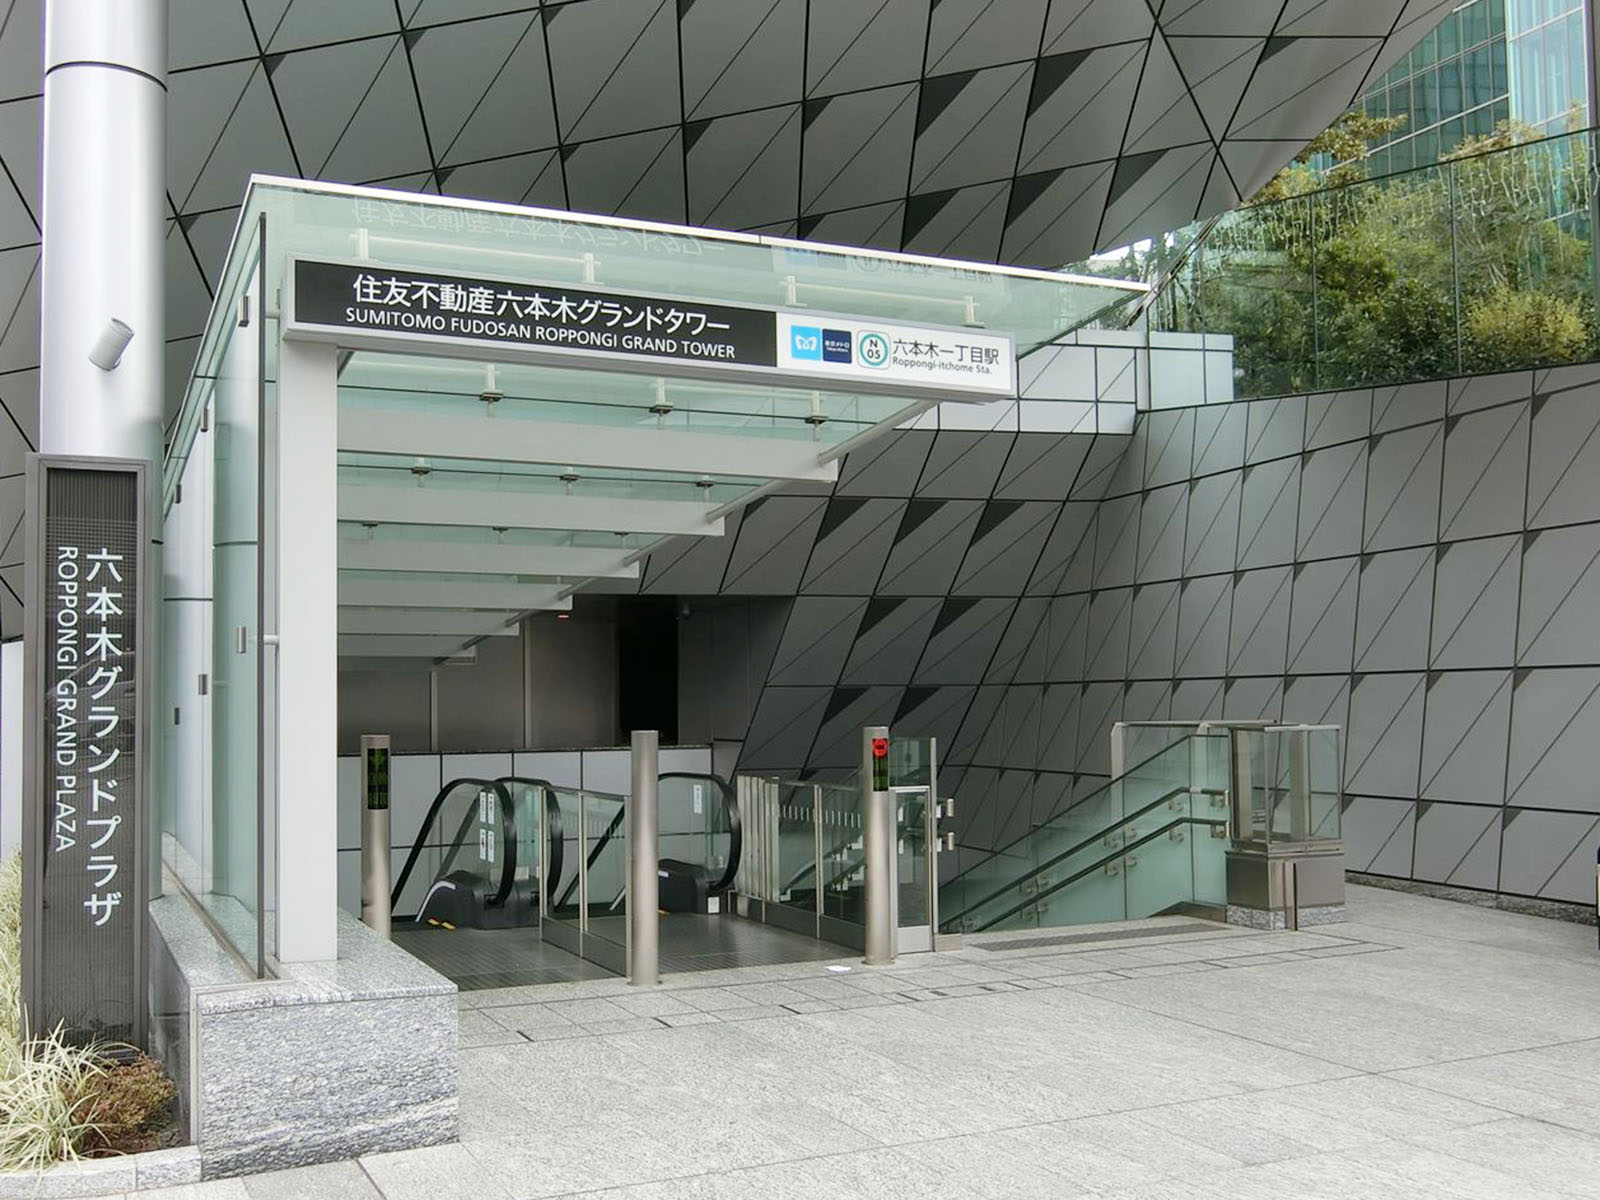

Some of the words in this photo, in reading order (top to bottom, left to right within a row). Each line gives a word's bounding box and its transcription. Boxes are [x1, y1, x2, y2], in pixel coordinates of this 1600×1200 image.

[346, 307, 446, 331] SUMITOMO
[450, 317, 531, 340] FUDOSAN
[535, 326, 618, 348] ROPPONGI
[622, 334, 677, 354] GRAND
[681, 340, 736, 359] TOWER
[353, 273, 730, 336] 住友不動産六本木グランドタワー
[866, 349, 881, 361] 05
[869, 338, 879, 349] N
[892, 338, 1000, 366] 六本木一丁目駅
[892, 355, 974, 374] Roppongi-itchome
[976, 365, 993, 375] Sta.
[56, 545, 79, 670] ROPPONGI
[56, 679, 78, 767] GRAND
[84, 547, 123, 927] 六本木グランドプラザ
[55, 775, 76, 852] PLAZA
